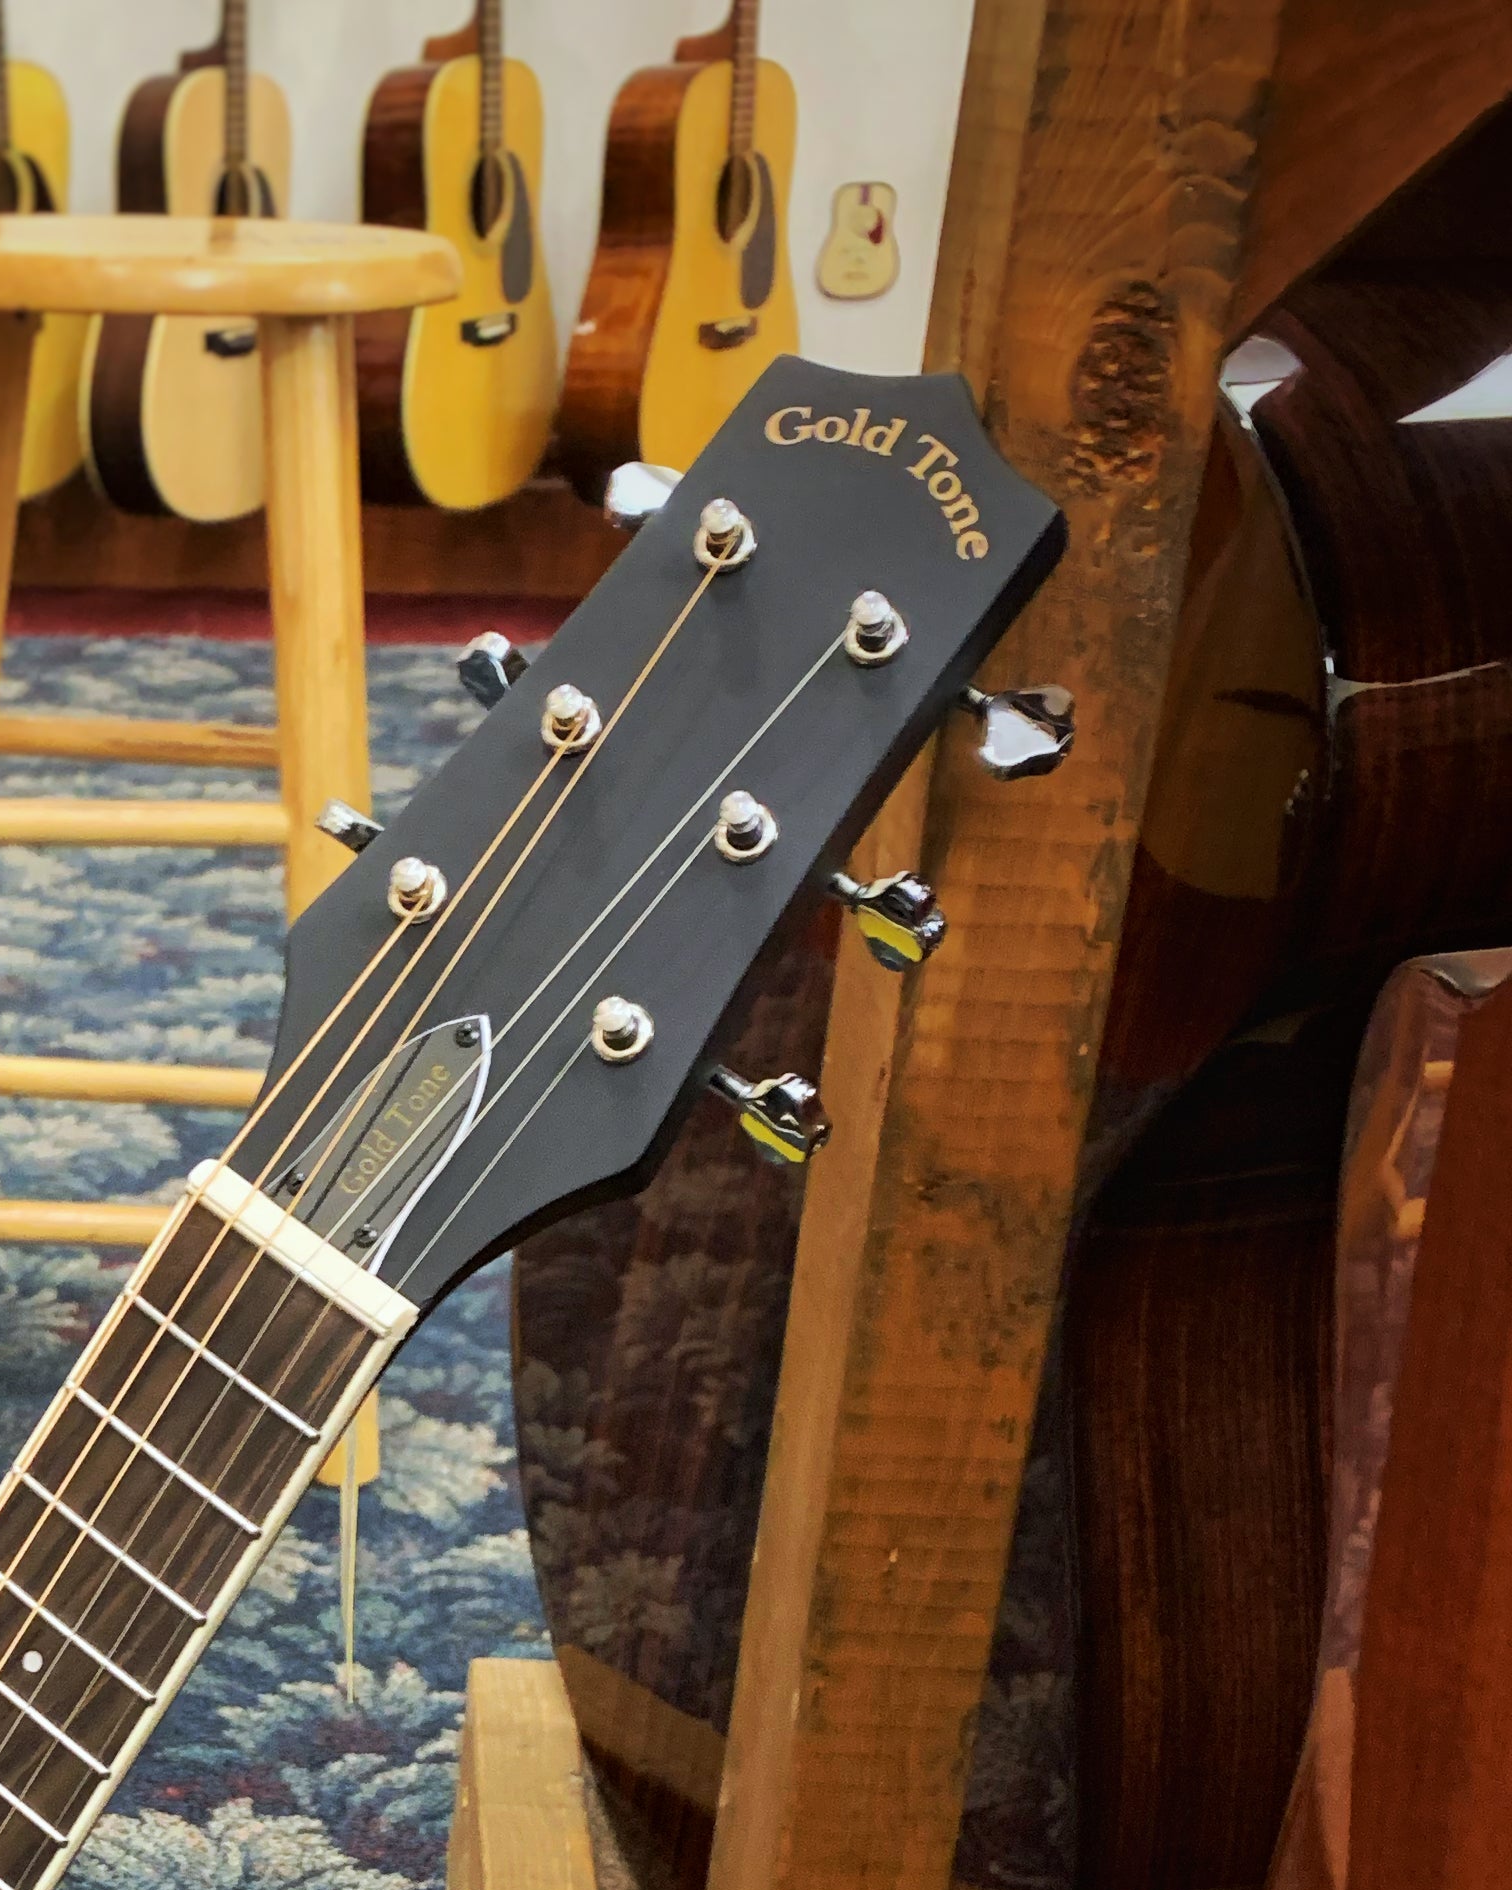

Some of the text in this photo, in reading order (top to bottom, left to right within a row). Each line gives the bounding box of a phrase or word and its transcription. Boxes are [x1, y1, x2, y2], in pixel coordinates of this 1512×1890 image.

[764, 406, 989, 560] Gold Tone
[341, 1063, 451, 1194] Gold Tone
